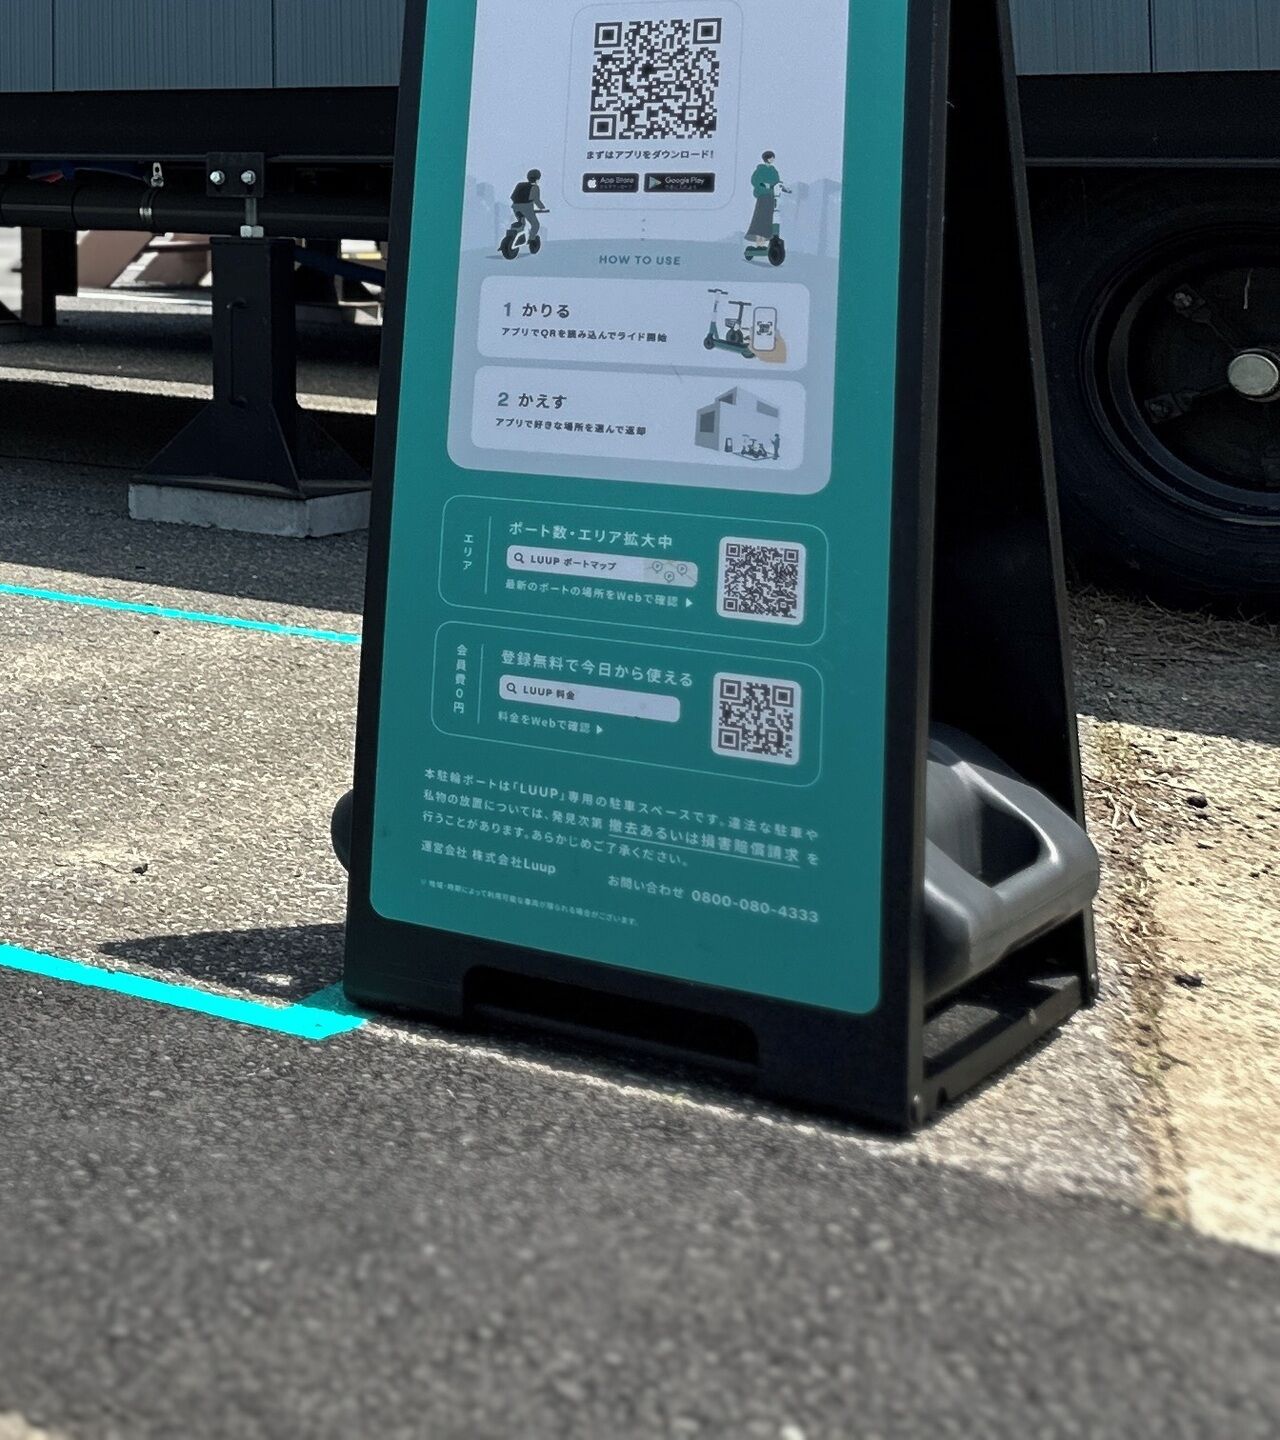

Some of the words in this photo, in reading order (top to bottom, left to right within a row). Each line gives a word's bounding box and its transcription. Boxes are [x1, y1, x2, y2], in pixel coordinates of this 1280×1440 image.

[664, 176, 689, 184] Google
[691, 177, 705, 185] Play
[598, 254, 630, 264] HOW
[635, 256, 652, 264] TO
[656, 256, 681, 266] USE
[504, 302, 512, 317] 1
[522, 302, 570, 318] かりる
[498, 392, 509, 407] 2
[518, 392, 567, 410] かえす
[496, 418, 647, 436] アプリで好きな場所を選んで返却
[508, 522, 673, 550] ポート数・エリア拡大中
[462, 534, 474, 570] エリア
[530, 554, 560, 566] LUUP
[563, 556, 616, 571] ポートマップ
[505, 578, 678, 607] 最新のポートの場所をWebで確認
[501, 649, 693, 688] 登録無料で今日から使える
[523, 685, 553, 696] LUUP
[556, 688, 575, 700] 料金
[498, 710, 591, 734] 料金をWebで確認
[422, 810, 688, 867] 行うことがあります。あらかじめご了承ください。
[421, 840, 468, 859] 運営会社
[472, 850, 556, 875] 株式会社Luup
[608, 874, 684, 899] お問い合わせ
[691, 890, 819, 923] 0800-080-4333
